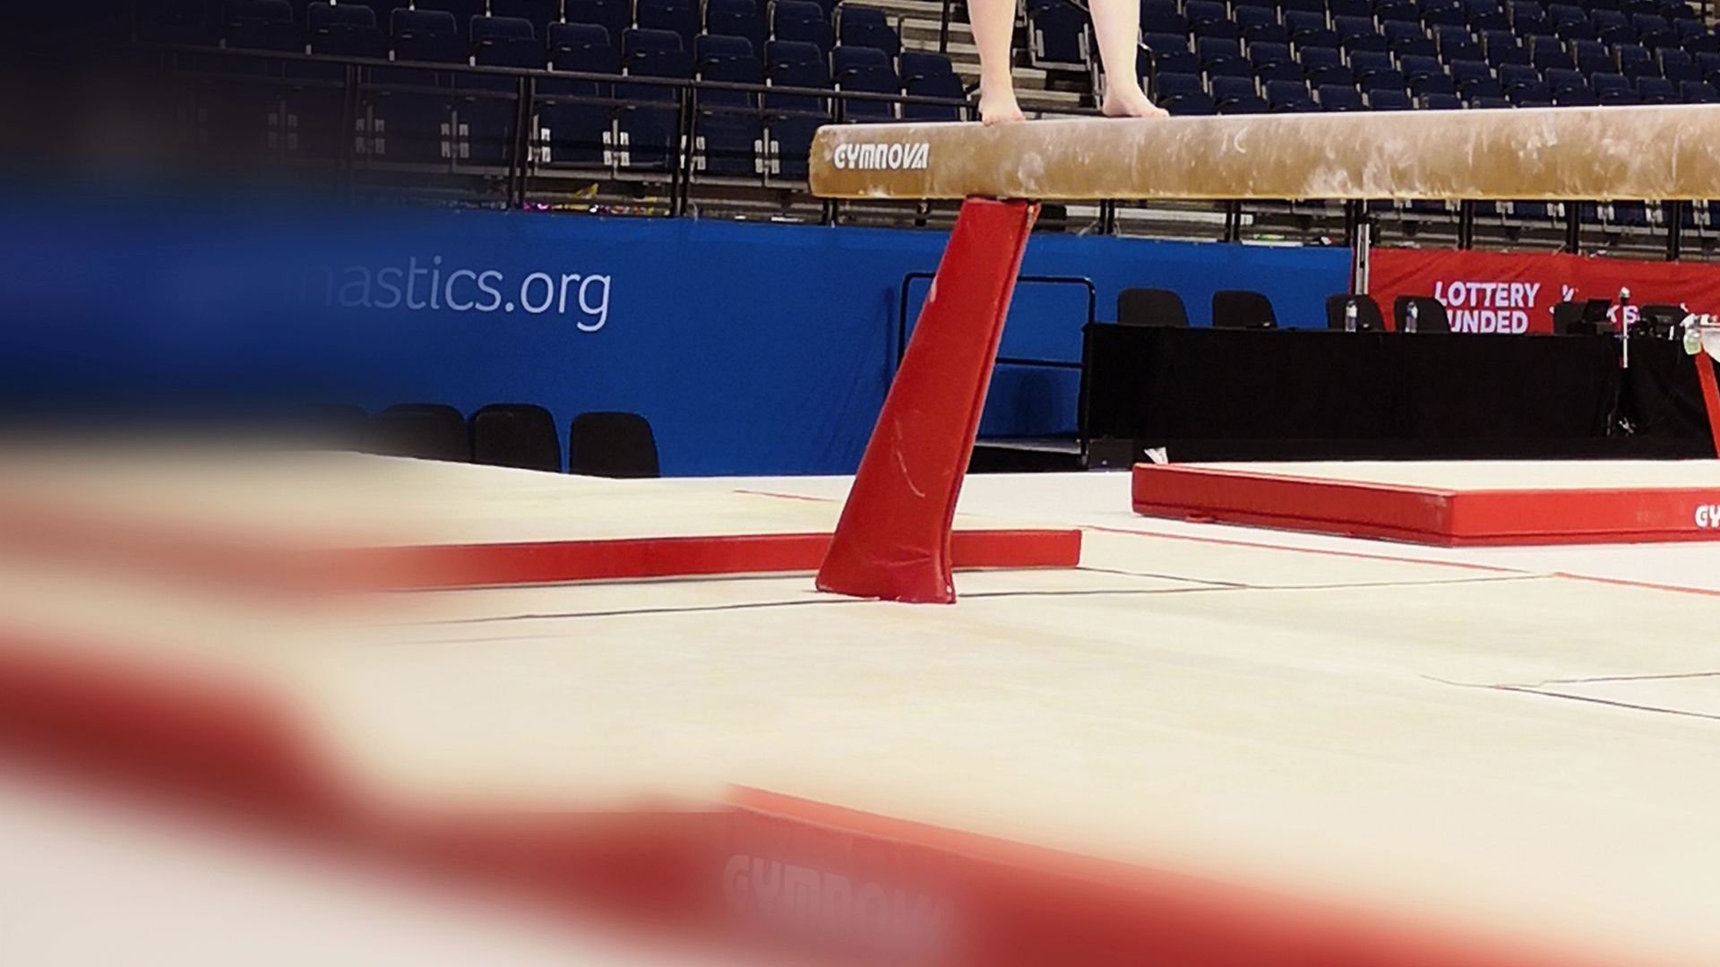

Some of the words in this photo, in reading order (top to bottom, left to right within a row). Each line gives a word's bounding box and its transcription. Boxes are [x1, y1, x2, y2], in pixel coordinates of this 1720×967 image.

[833, 142, 930, 169] GYMNOVA
[1434, 280, 1540, 308] LOTTERY
[1446, 309, 1530, 335] UNDED
